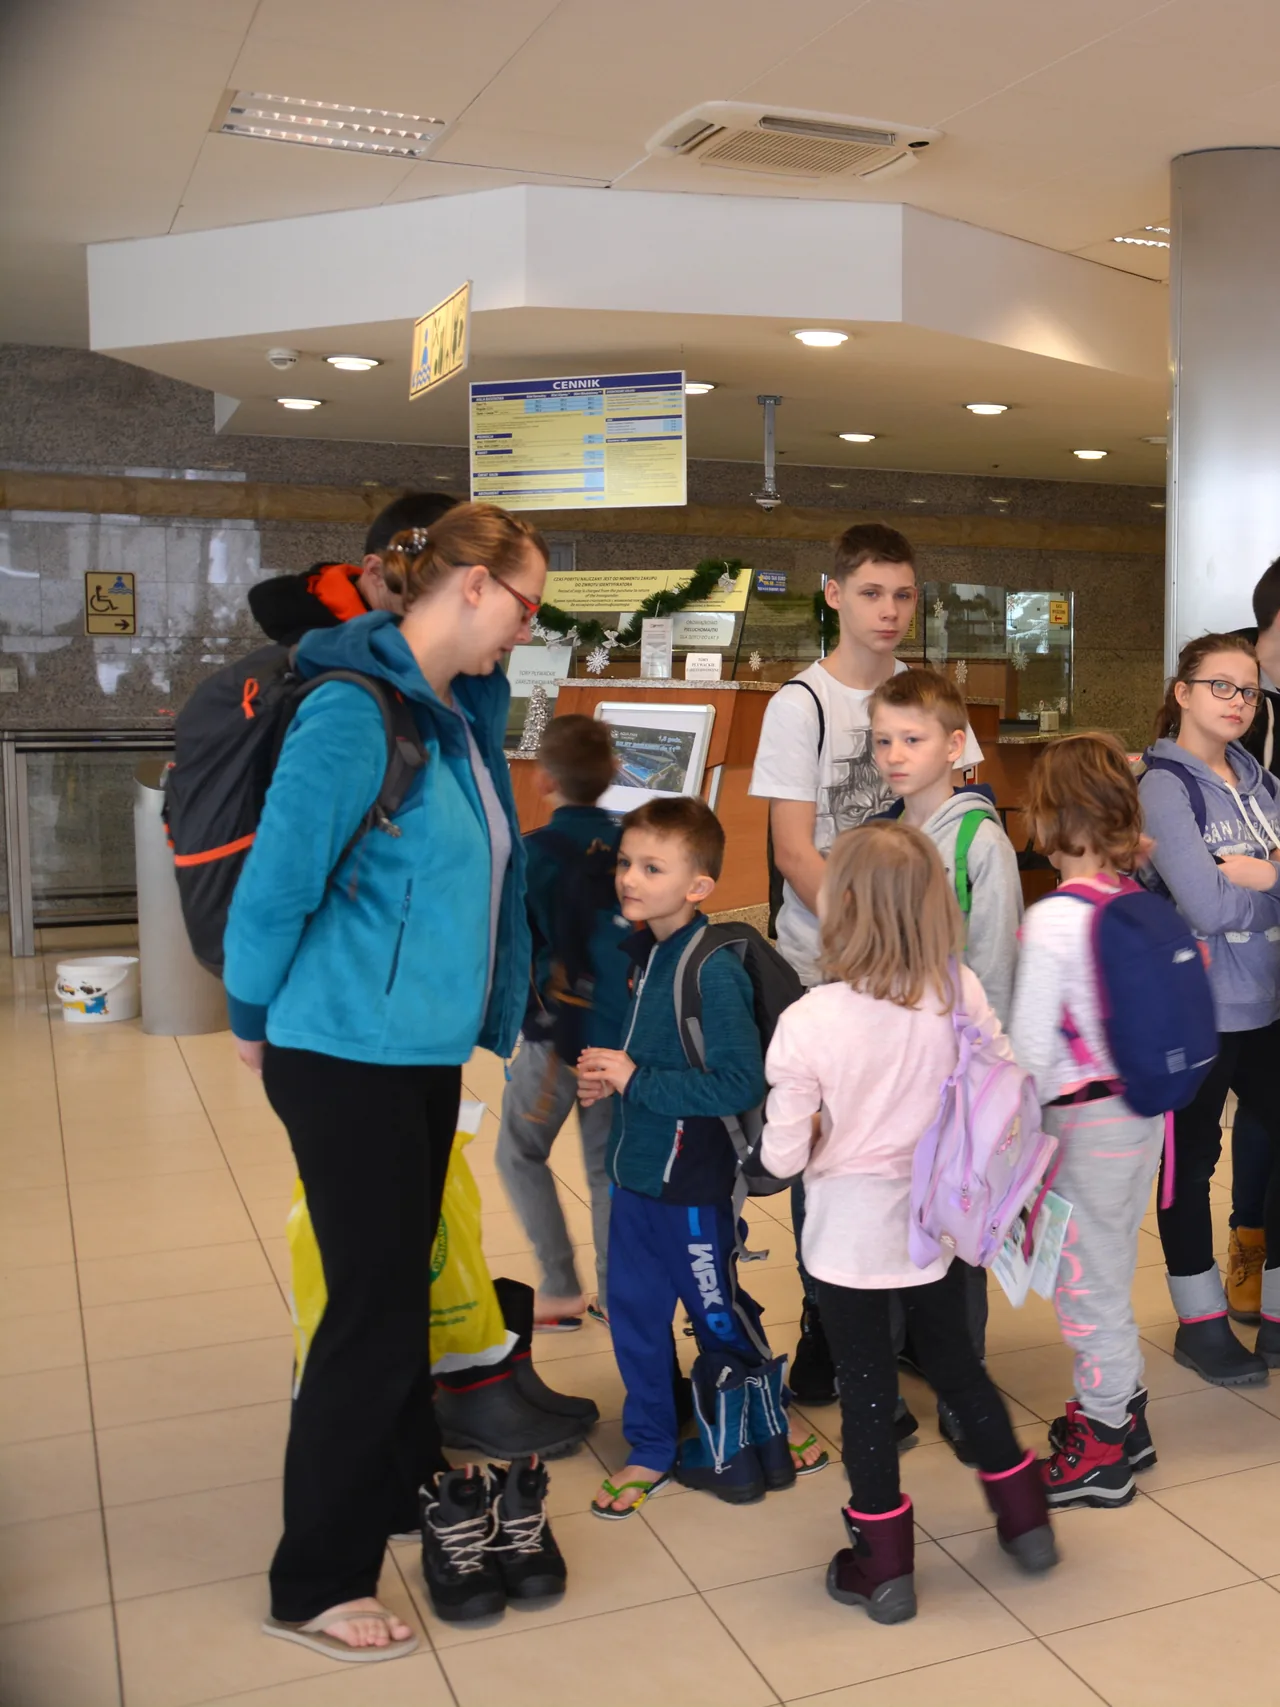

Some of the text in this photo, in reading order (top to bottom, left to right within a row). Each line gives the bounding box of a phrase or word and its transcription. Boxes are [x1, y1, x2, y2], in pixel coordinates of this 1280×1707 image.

[553, 378, 601, 391] CENNIK
[1203, 820, 1233, 844] SAN
[687, 1243, 724, 1310] WRX
